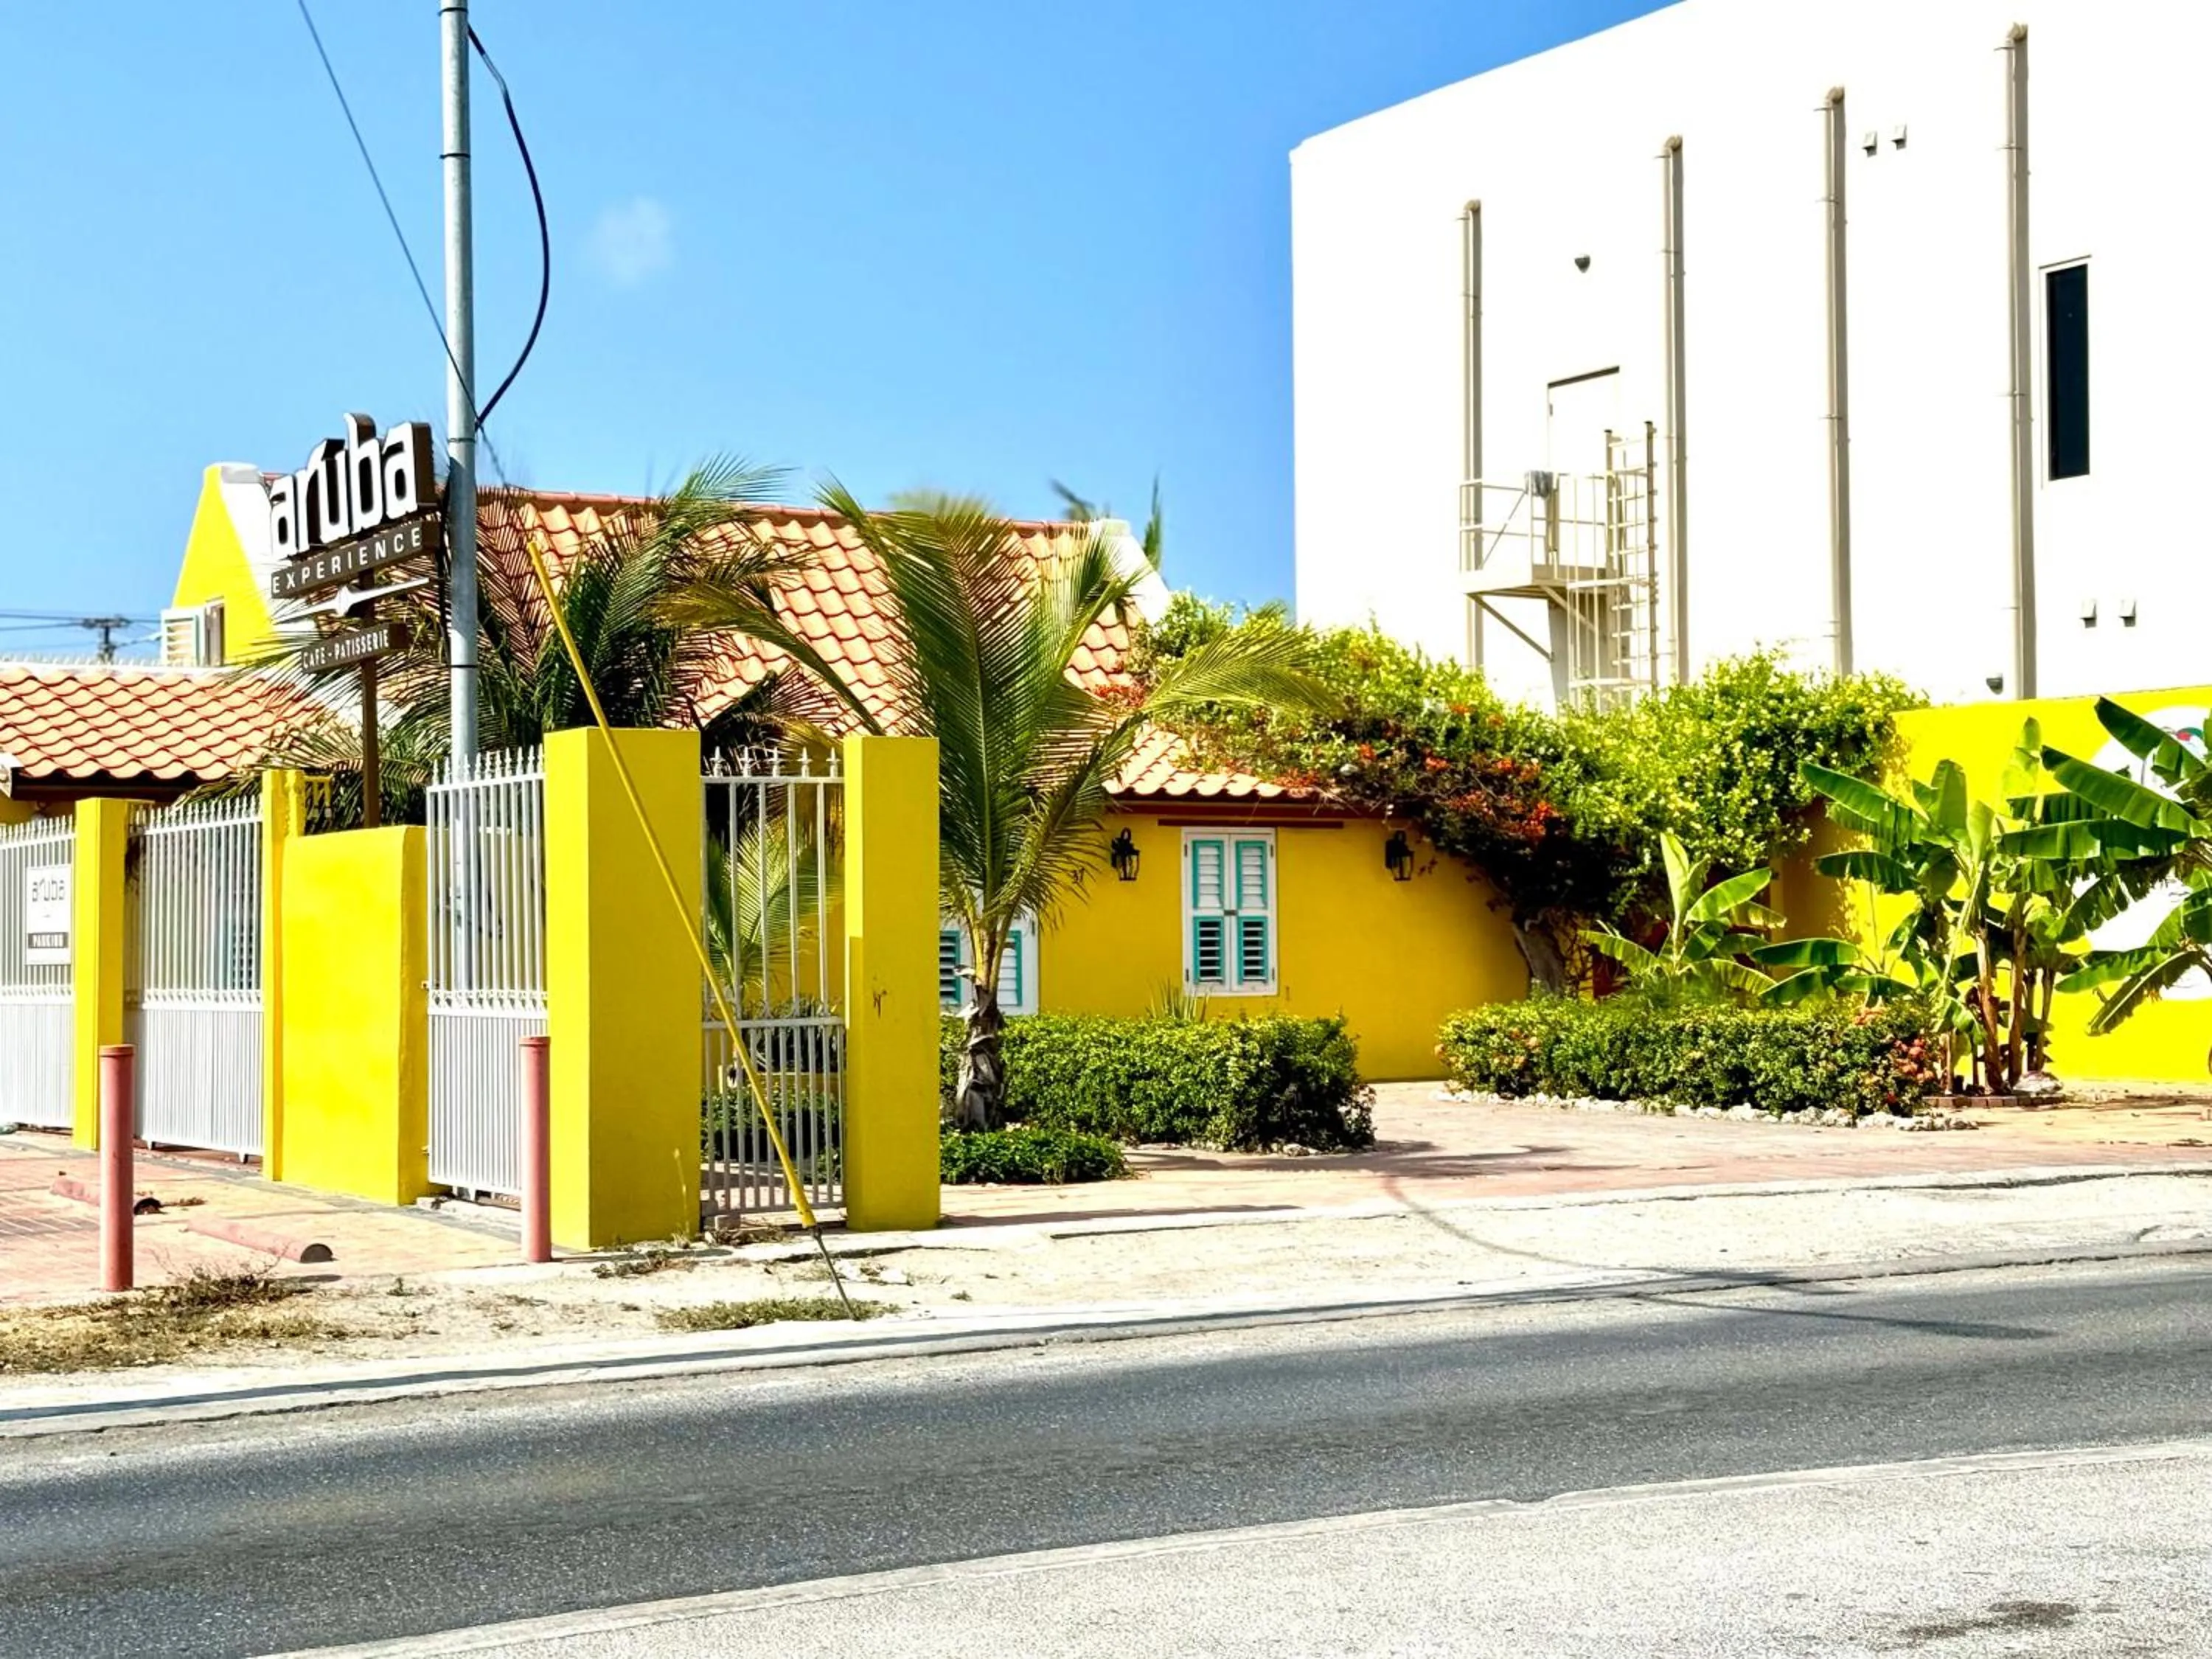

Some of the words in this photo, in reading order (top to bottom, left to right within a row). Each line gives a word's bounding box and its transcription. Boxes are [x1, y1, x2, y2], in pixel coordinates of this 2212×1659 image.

[270, 412, 418, 560] aruba
[272, 526, 421, 594] EXPERIENCE
[334, 628, 389, 661] PATISSERIE
